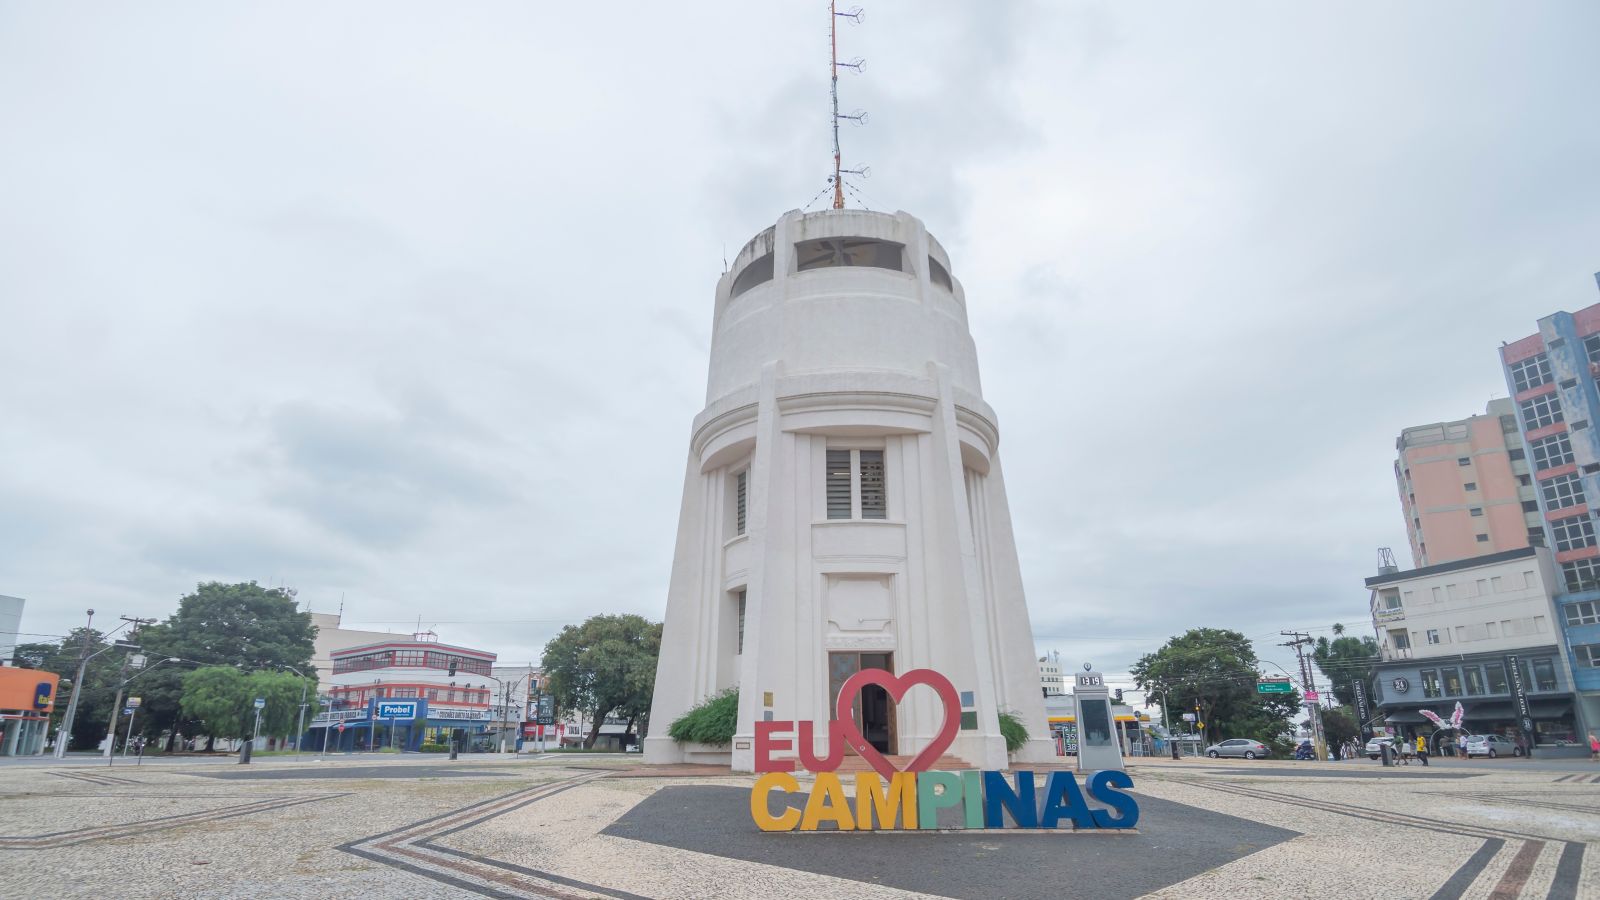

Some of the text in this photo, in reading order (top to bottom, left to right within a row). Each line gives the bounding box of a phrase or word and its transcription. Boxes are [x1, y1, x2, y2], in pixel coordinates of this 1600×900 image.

[384, 706, 410, 714] Probel
[754, 720, 846, 773] EU
[751, 770, 1138, 832] CAMPINAS
